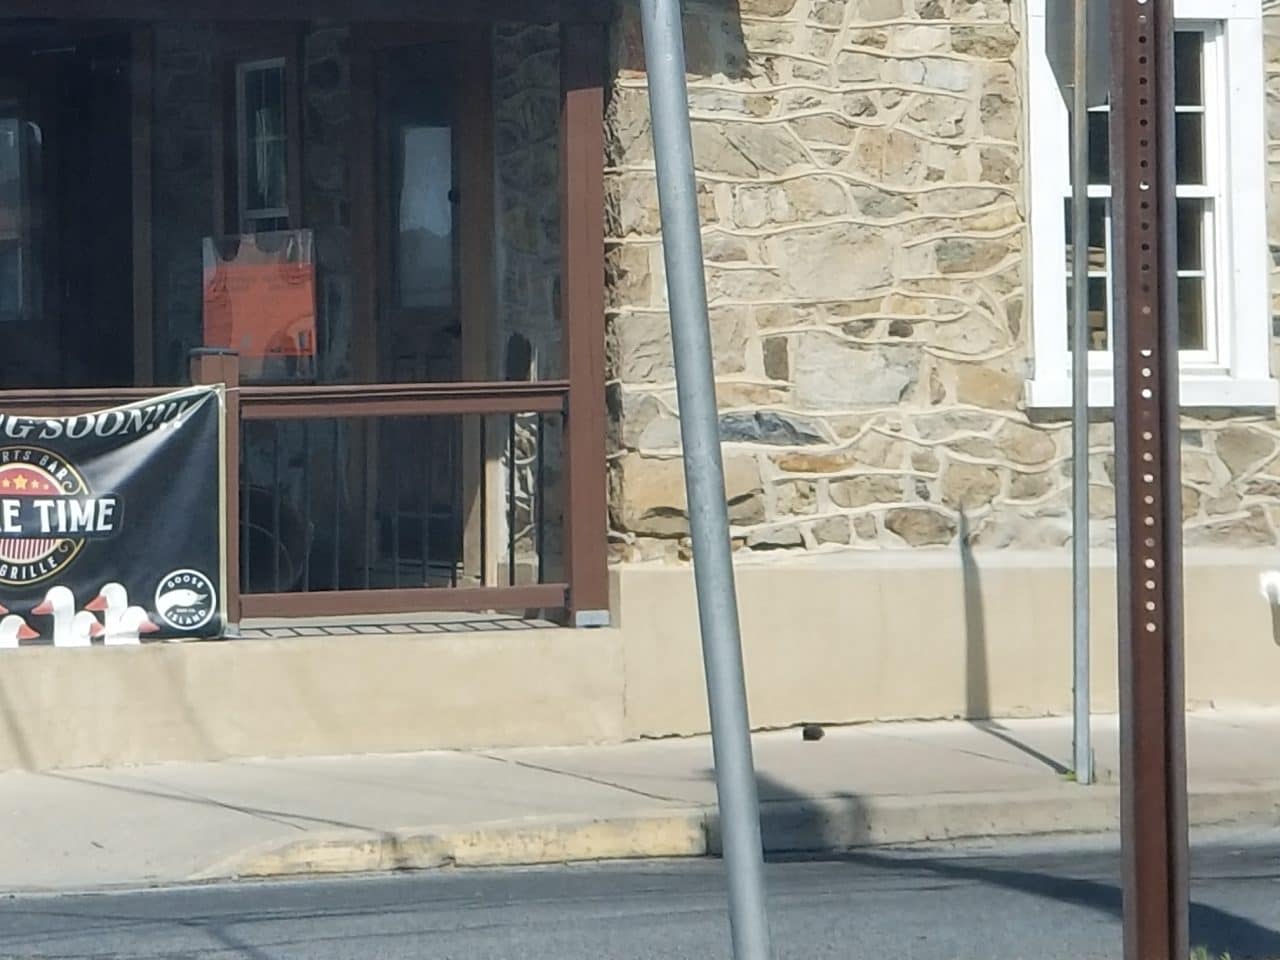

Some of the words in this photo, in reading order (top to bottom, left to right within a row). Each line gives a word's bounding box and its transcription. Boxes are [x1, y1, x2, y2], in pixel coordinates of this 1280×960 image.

[38, 454, 70, 481] BAR
[33, 498, 116, 533] TIME
[167, 574, 205, 589] GOOSE
[166, 609, 207, 625] ISLAND
